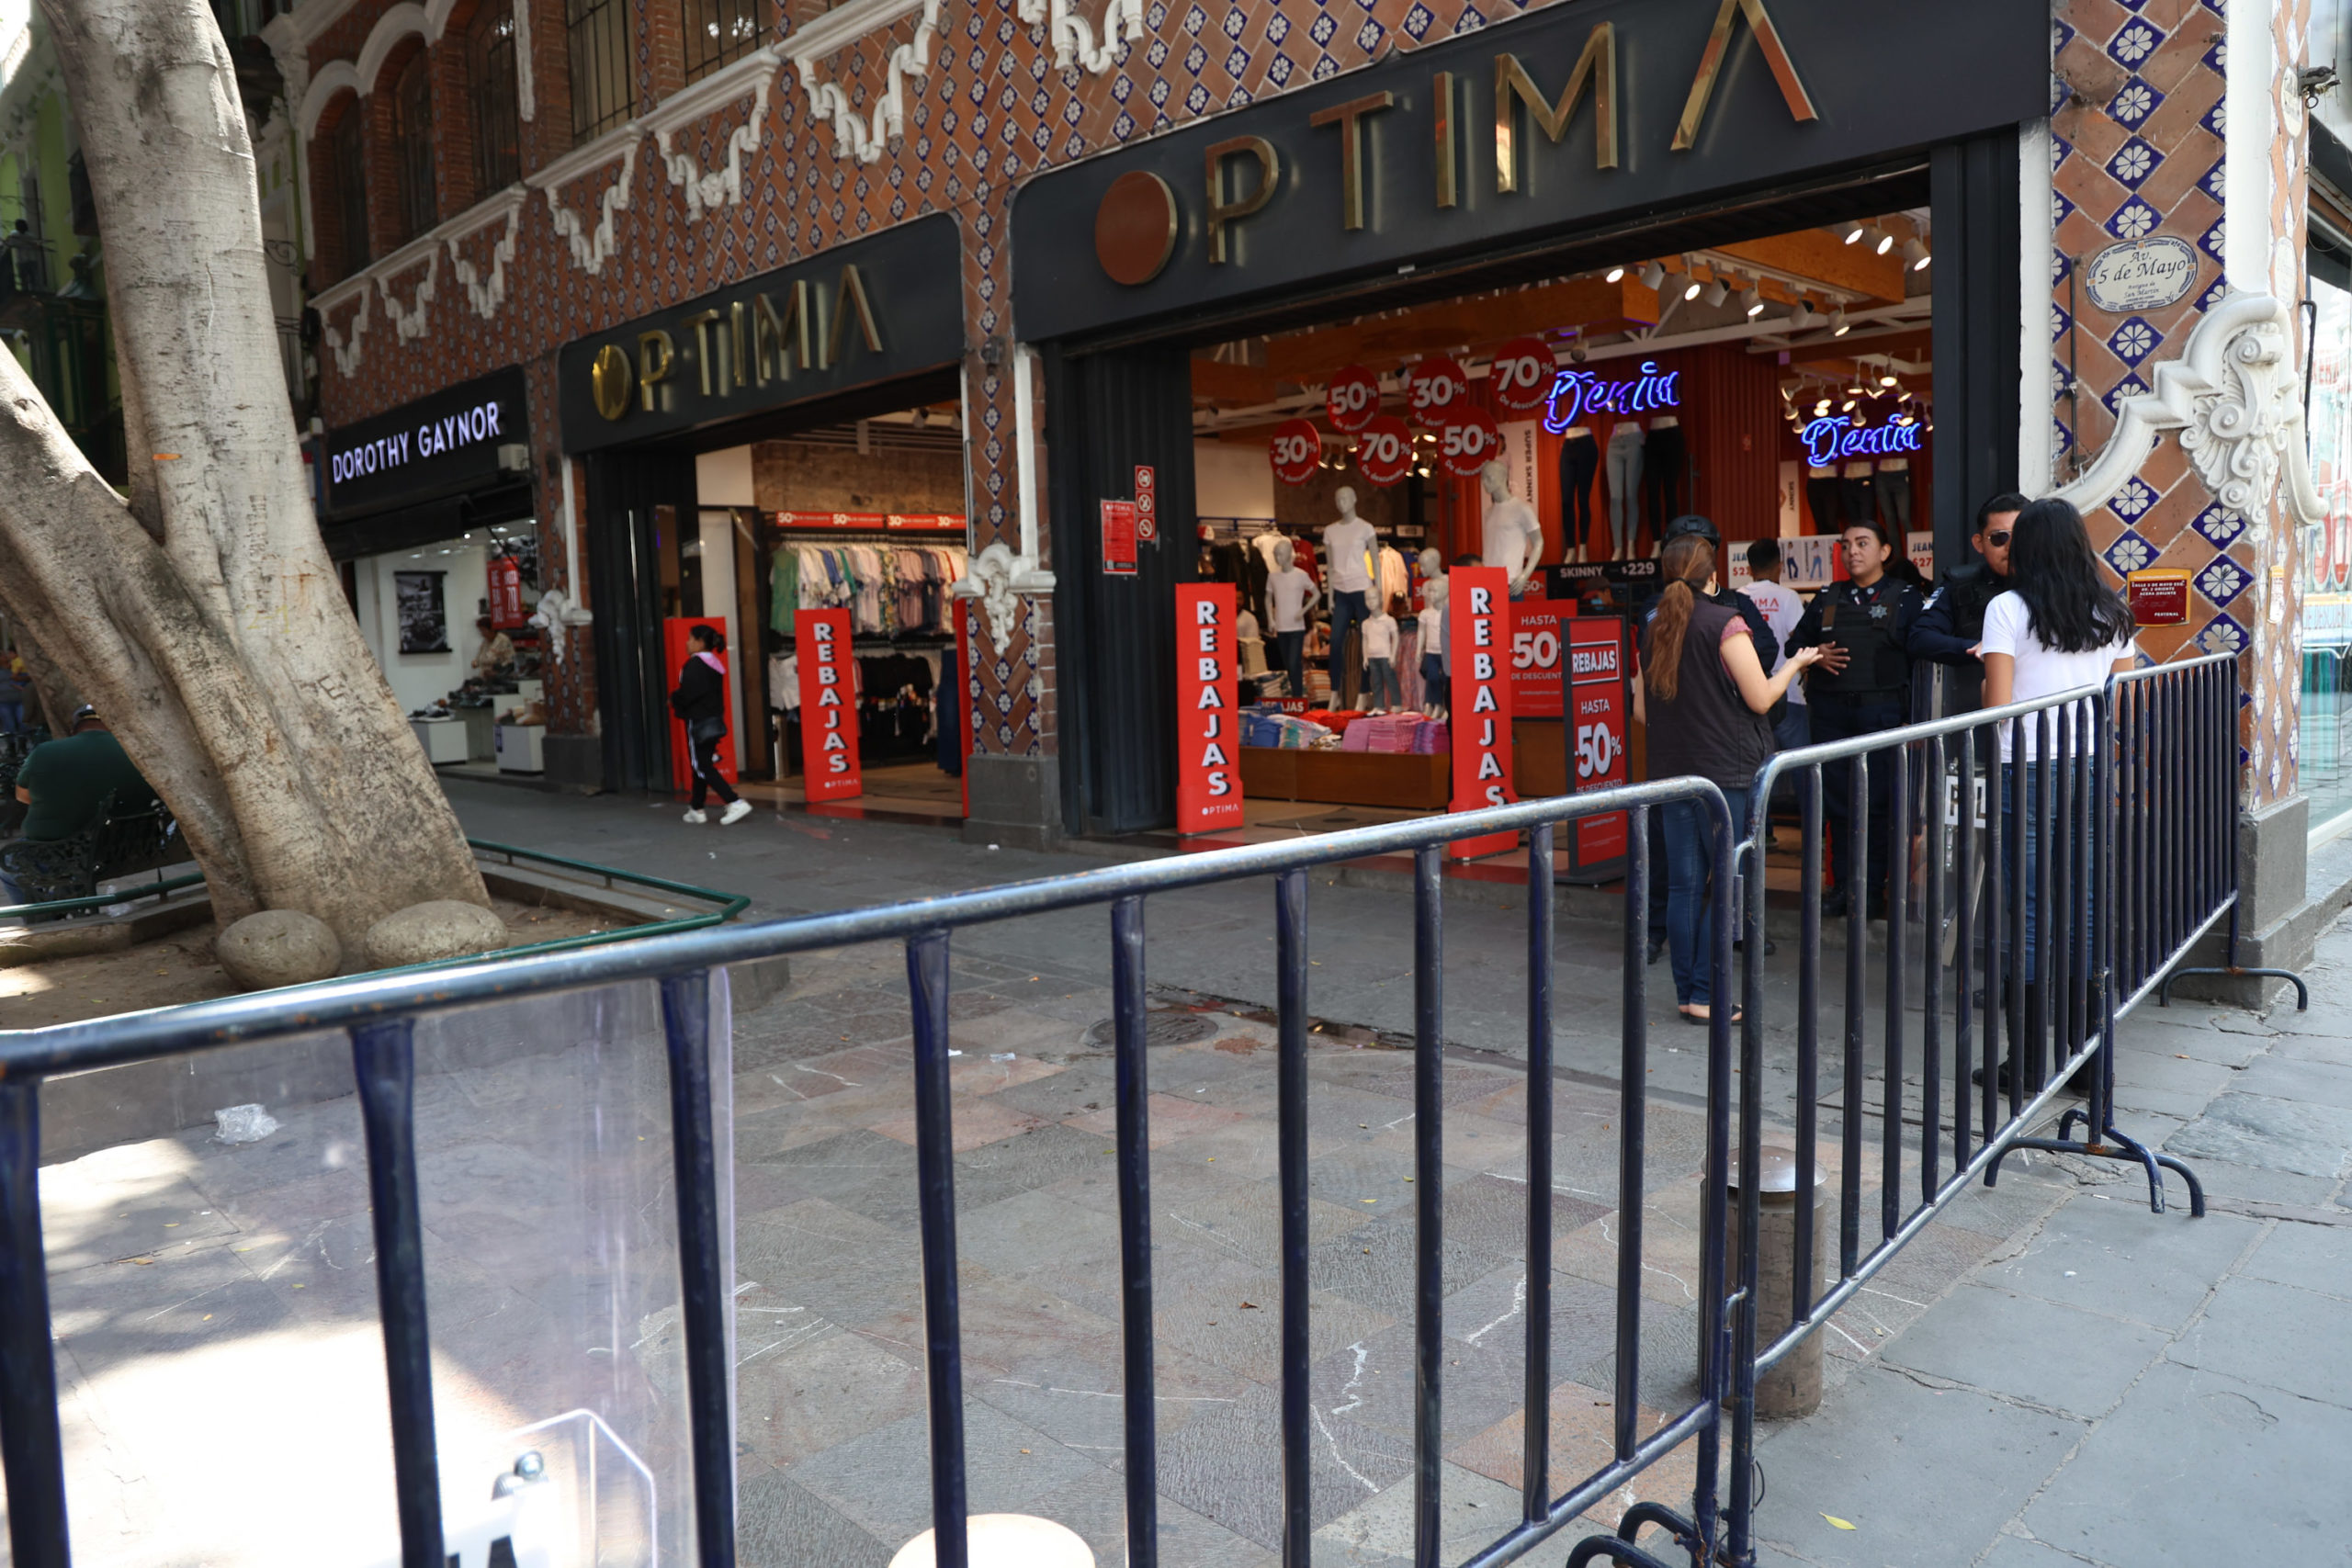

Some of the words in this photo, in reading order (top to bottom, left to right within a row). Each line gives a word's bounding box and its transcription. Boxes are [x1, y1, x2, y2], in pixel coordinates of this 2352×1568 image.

[1094, 0, 1819, 286] OPTIMA
[2098, 267, 2109, 284] 5
[2113, 264, 2132, 281] de
[2136, 258, 2187, 279] Mayo
[2130, 251, 2152, 263] Av.
[592, 264, 883, 421] OPTIMA
[1490, 355, 1555, 392] -70%
[1328, 381, 1378, 416] -50%
[1408, 375, 1466, 409] -30%
[1543, 361, 1681, 434] Denim
[332, 431, 410, 484] DOROTHY
[418, 401, 501, 457] GAYNOR
[1271, 434, 1317, 466] -30%
[1358, 433, 1412, 464] -70%
[1439, 423, 1497, 457] -50%
[1523, 429, 1532, 463] SUPER
[1801, 413, 1921, 468] Denim
[1525, 466, 1533, 503] SKINNY
[1560, 565, 1603, 579] SKINNY
[1622, 561, 1656, 576] $229
[1733, 552, 1748, 562] JEA
[1521, 615, 1557, 626] HASTA
[1509, 631, 1562, 669] -50
[1572, 649, 1617, 673] REBAJAS
[1510, 671, 1521, 681] DE
[1522, 671, 1562, 681] DESCUENT
[813, 622, 848, 773] REBAJAS
[1195, 601, 1229, 796] REBAJAS
[1470, 586, 1504, 809] REBAJAS
[1580, 698, 1611, 715] HASTA
[1574, 722, 1623, 779] -50%
[825, 778, 858, 789] OPTIMA
[1201, 803, 1238, 816] OPTIMA
